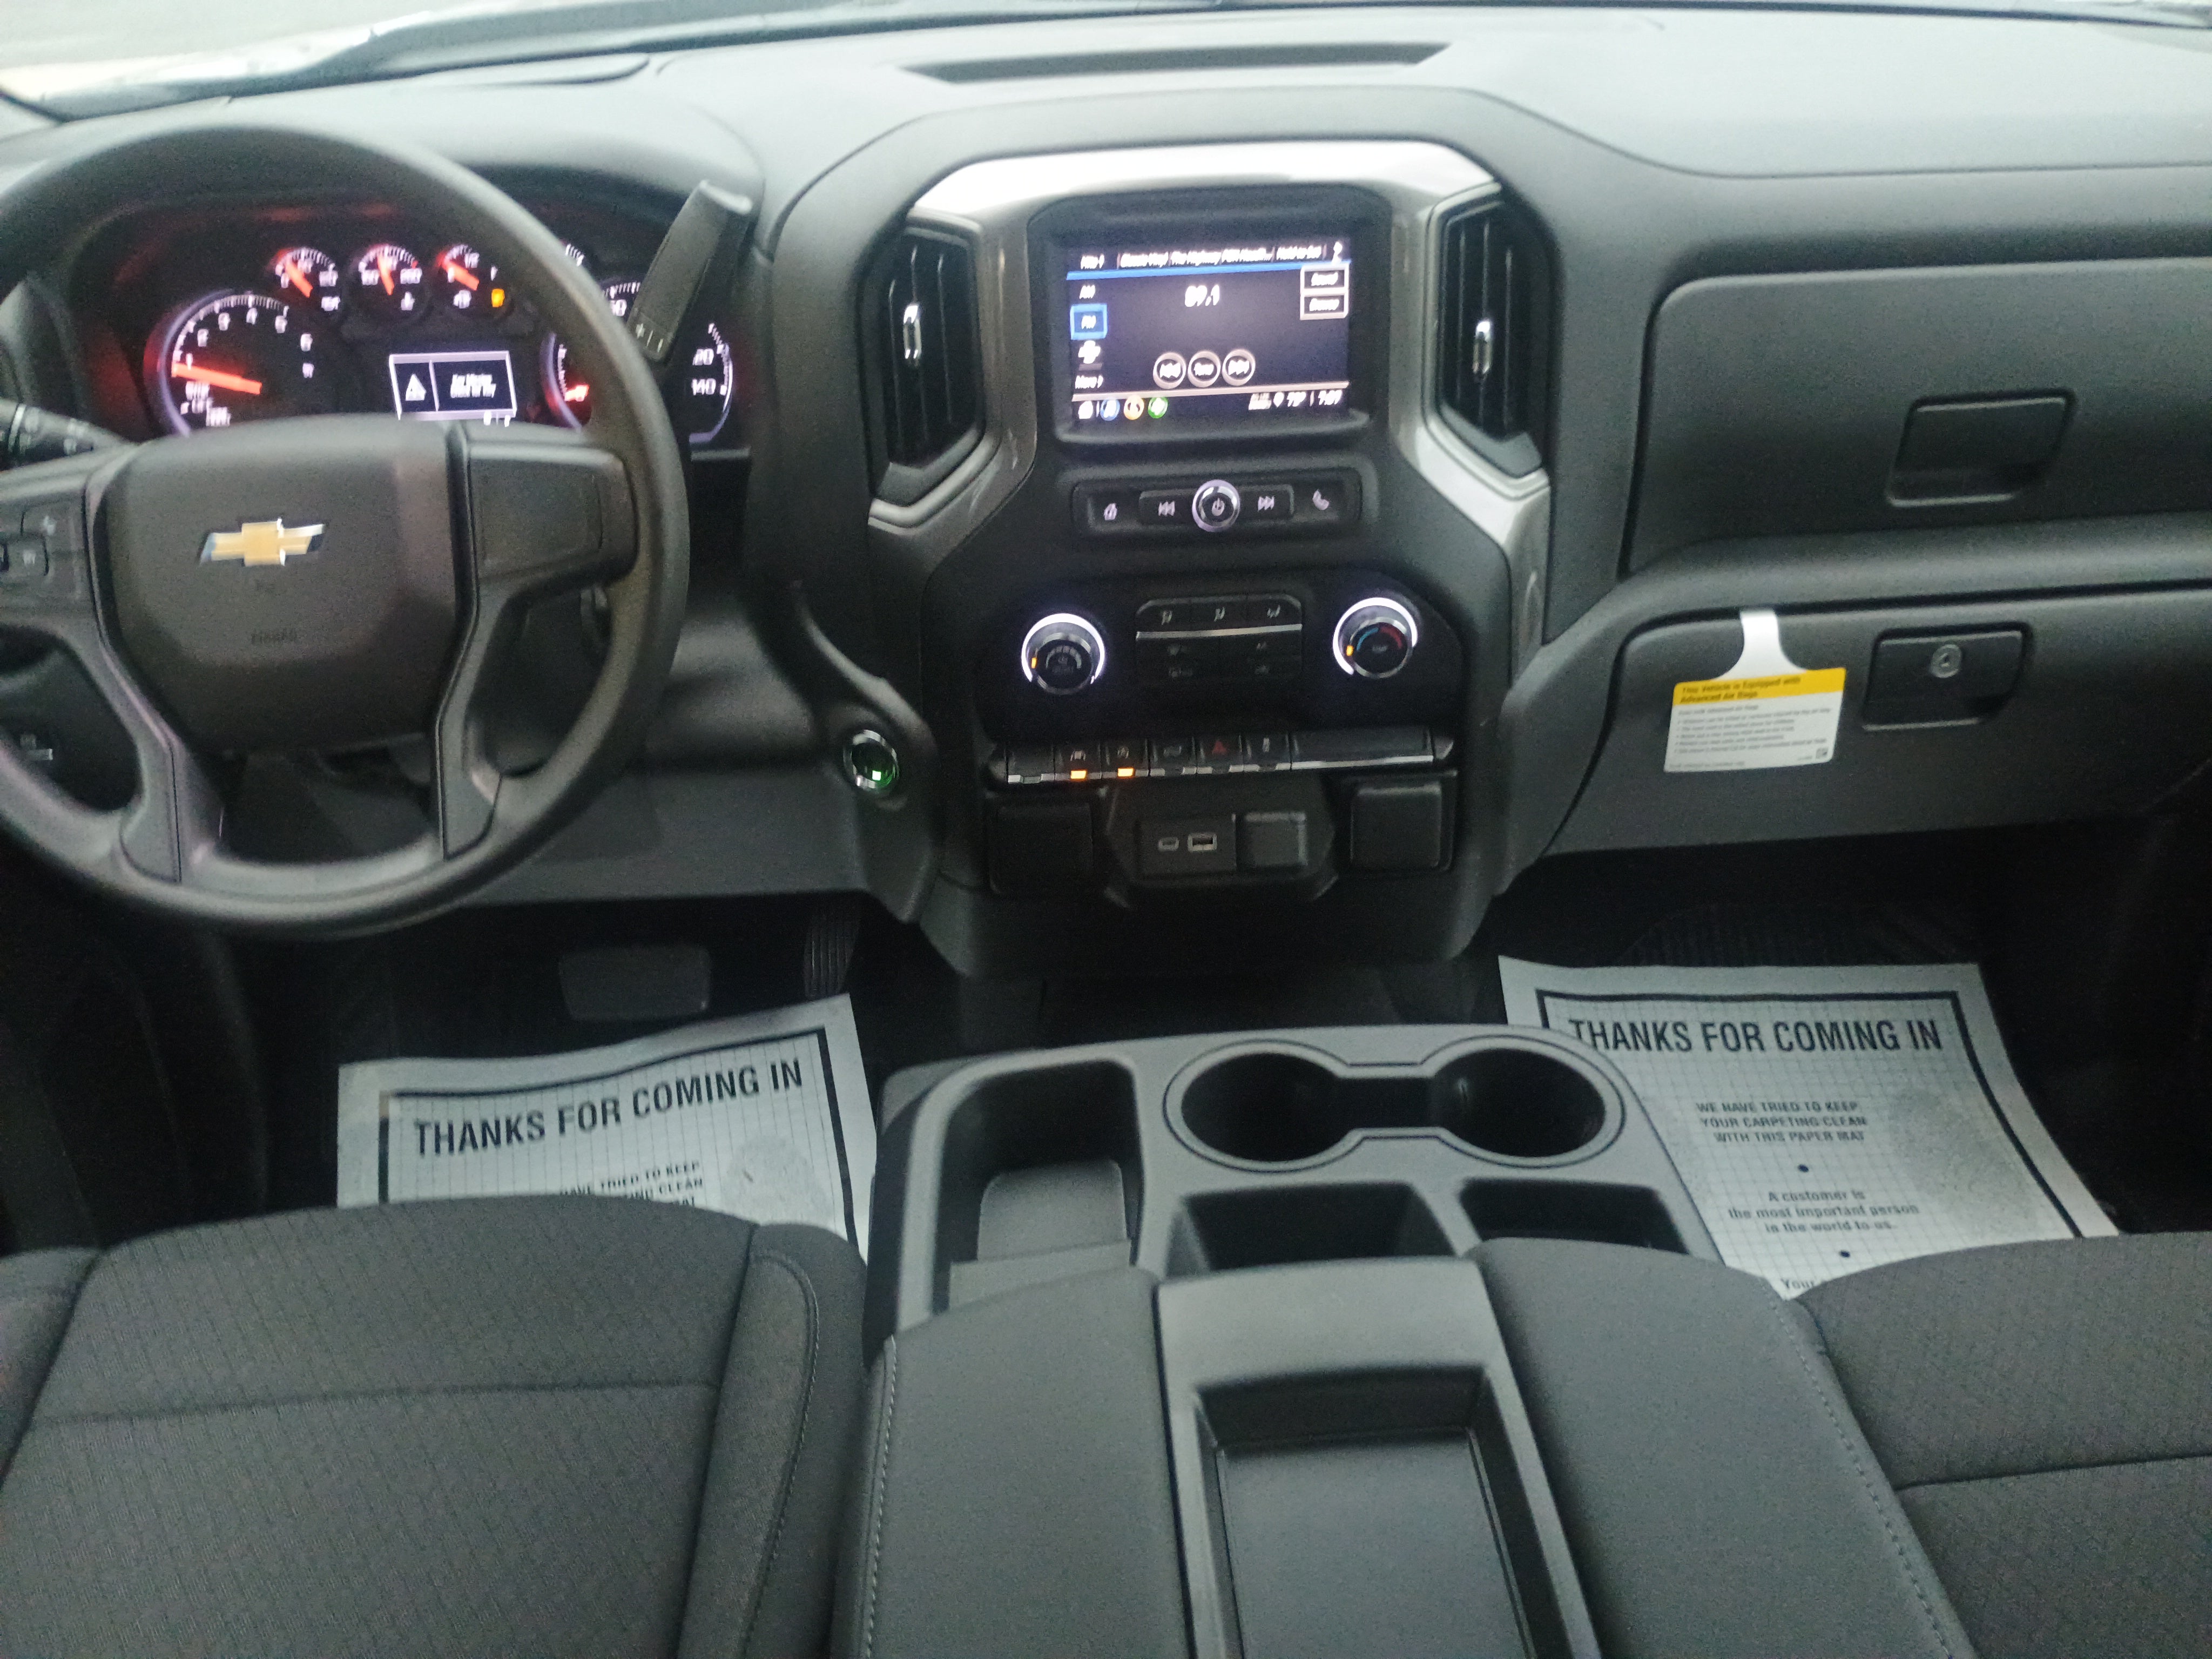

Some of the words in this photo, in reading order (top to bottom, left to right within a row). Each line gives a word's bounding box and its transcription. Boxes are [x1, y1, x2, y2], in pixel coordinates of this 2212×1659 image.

[1742, 678, 1782, 689] Equipped
[1680, 693, 1721, 703] Advanced
[1568, 1017, 1692, 1052] THANKS
[1703, 1021, 1765, 1053] FOR
[1773, 1020, 1901, 1053] COMING
[1908, 1019, 1943, 1051] IN
[414, 1109, 545, 1156] THANKS
[558, 1097, 622, 1135] FOR
[632, 1065, 760, 1118] COMING
[770, 1058, 803, 1090] IN
[1697, 1102, 1716, 1112] WE
[1722, 1102, 1755, 1112] HAVE
[1761, 1101, 1800, 1112] TRIED
[1804, 1101, 1821, 1112] TO
[1825, 1101, 1858, 1112] KEEP
[1701, 1117, 1739, 1128] YOUR
[1742, 1116, 1819, 1128] CARPETING
[1822, 1116, 1866, 1127] CLEAN
[1714, 1132, 1750, 1143] WITH
[1755, 1132, 1785, 1142] THIS
[1788, 1131, 1833, 1142] PAPER
[1836, 1130, 1865, 1141] MAT
[645, 1168, 660, 1179] TO
[666, 1161, 700, 1176] KEEP
[658, 1177, 702, 1195] CLEAN
[1768, 1191, 1778, 1202] A
[1782, 1190, 1848, 1202] customer
[1852, 1189, 1866, 1201] is
[1728, 1207, 1751, 1219] the
[1756, 1207, 1791, 1218] most
[1796, 1205, 1865, 1218] important
[1869, 1204, 1919, 1216] person
[1765, 1222, 1779, 1233] in
[1782, 1221, 1806, 1233] the
[1811, 1219, 1852, 1232] world
[1854, 1219, 1870, 1230] to
